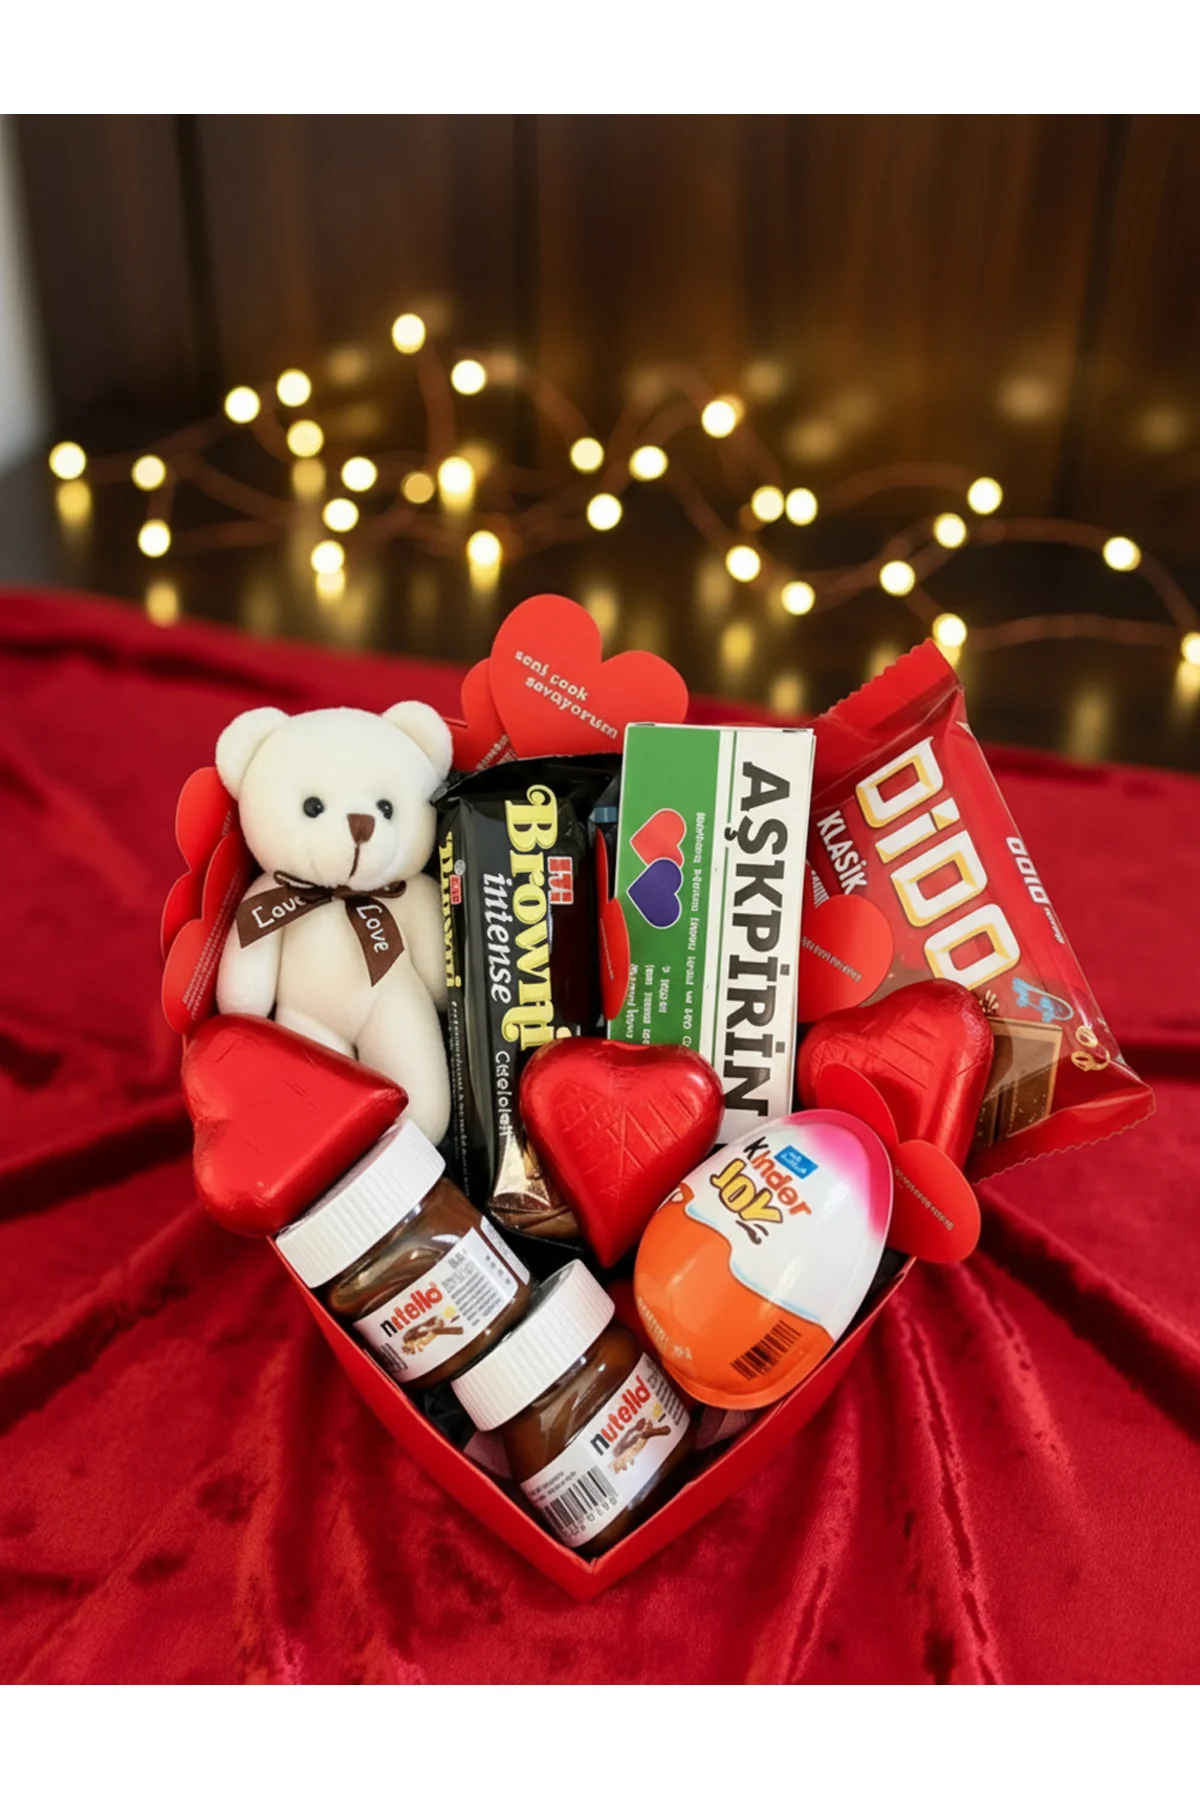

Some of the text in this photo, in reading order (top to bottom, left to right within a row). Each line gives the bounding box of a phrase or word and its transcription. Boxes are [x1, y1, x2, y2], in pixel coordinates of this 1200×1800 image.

[816, 810, 869, 894] KLASİK
[356, 904, 390, 953] Love
[482, 873, 512, 1004] intense
[723, 761, 791, 1117] AŞKPİRİN
[742, 1136, 811, 1218] Kinder
